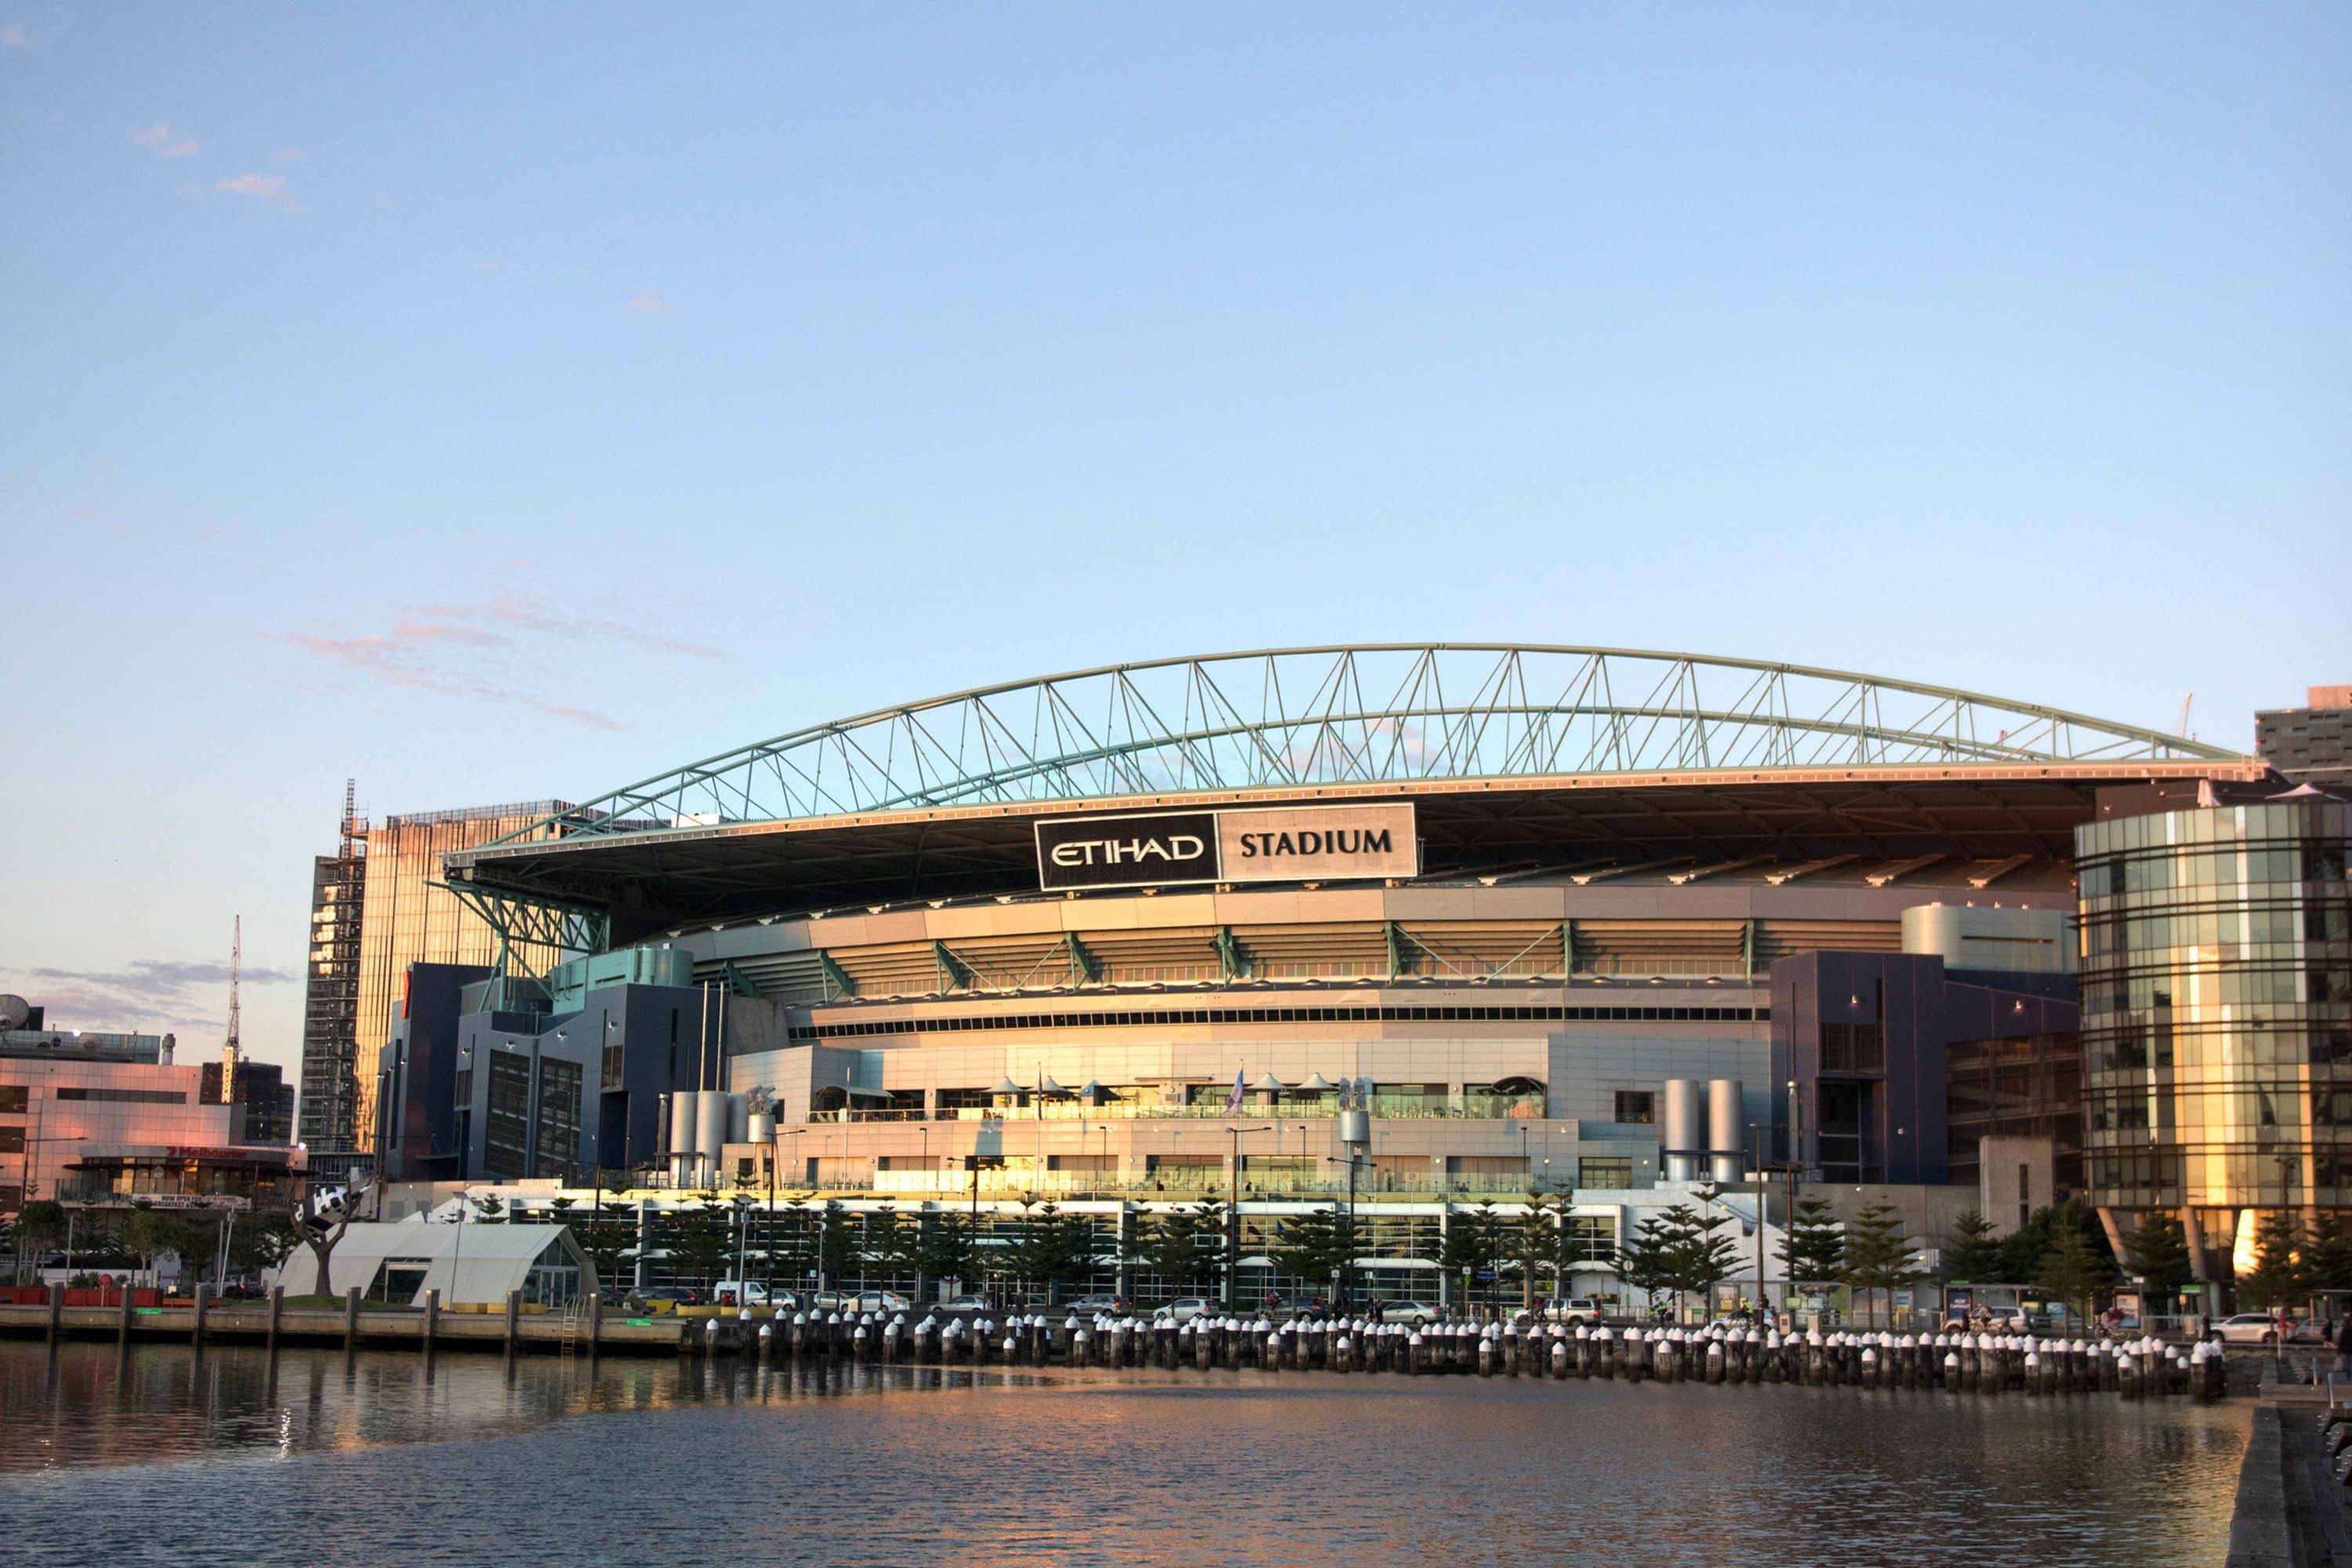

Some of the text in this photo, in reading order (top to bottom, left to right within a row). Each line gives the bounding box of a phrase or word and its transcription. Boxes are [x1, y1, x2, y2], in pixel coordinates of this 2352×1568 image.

[1051, 828, 1393, 866] ETIHAD STADIUM
[180, 1146, 247, 1159] Melbourne
